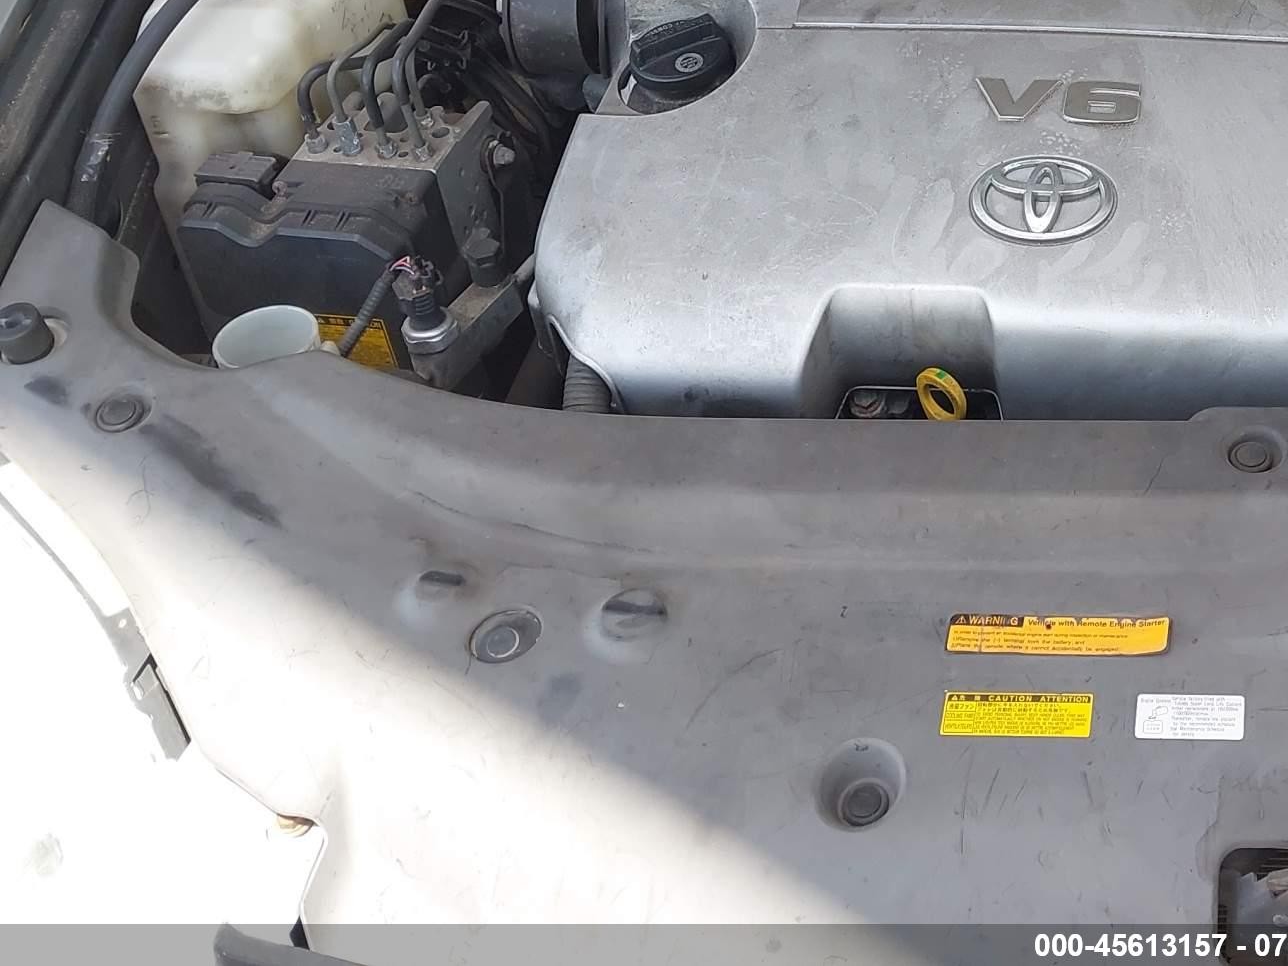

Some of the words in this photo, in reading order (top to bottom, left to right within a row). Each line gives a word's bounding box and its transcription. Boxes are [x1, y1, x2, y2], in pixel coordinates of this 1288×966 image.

[975, 77, 1142, 125] V6
[968, 615, 1019, 626] WARNIG
[1076, 620, 1107, 628] Remote
[1109, 620, 1137, 629] Engine
[1138, 619, 1166, 628] Starter
[1039, 695, 1089, 703] ATTENTION
